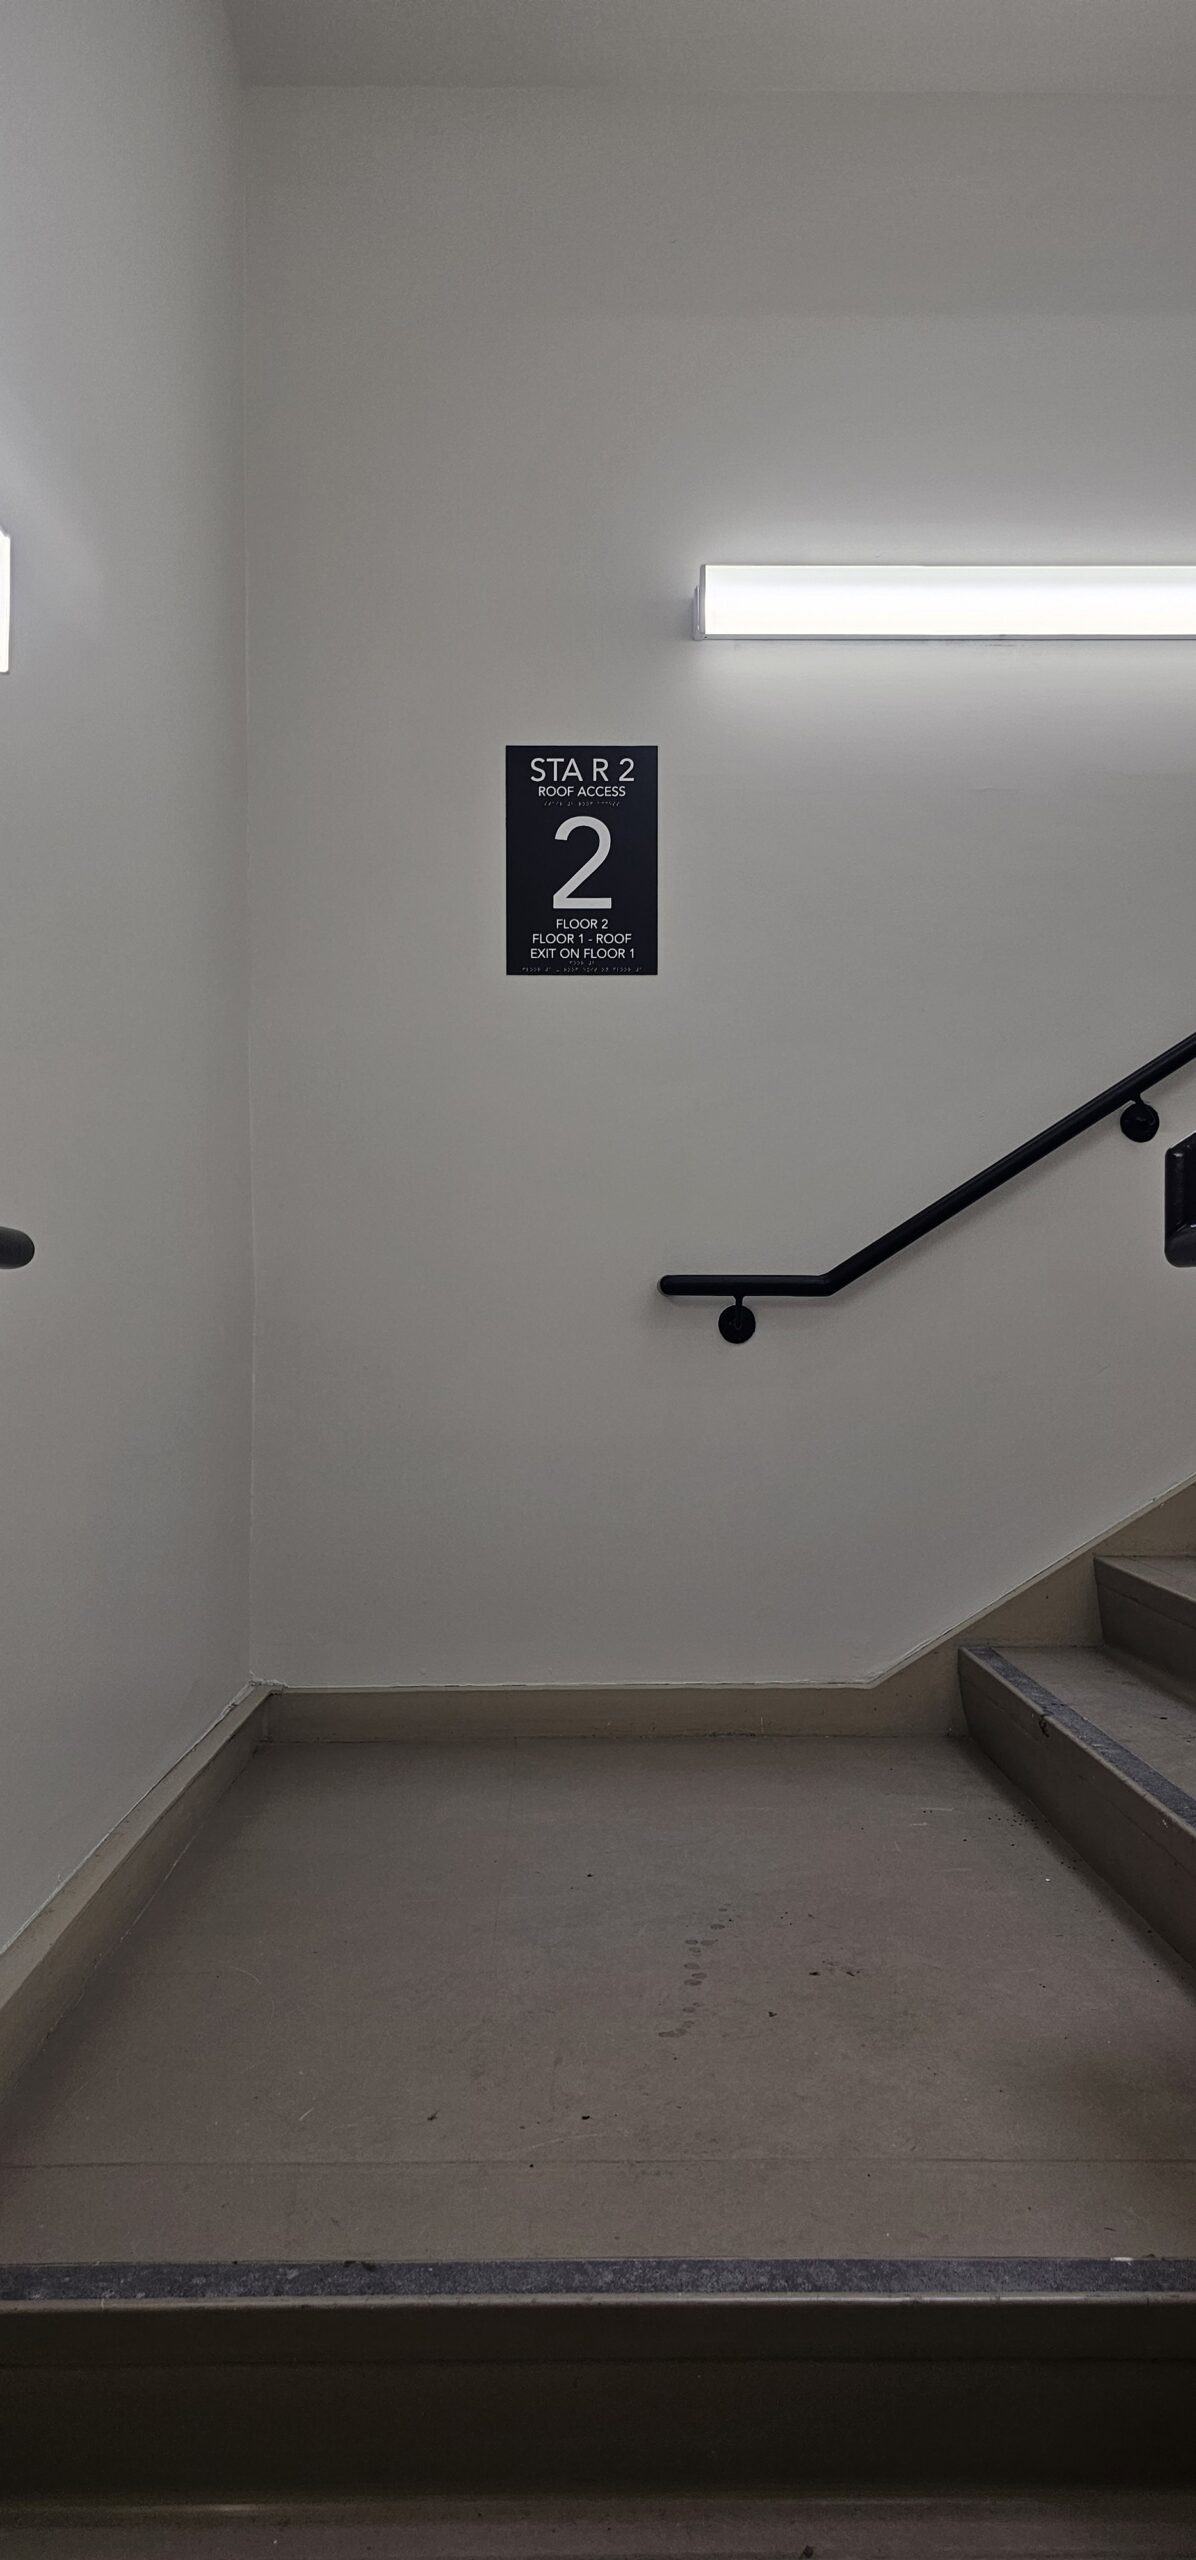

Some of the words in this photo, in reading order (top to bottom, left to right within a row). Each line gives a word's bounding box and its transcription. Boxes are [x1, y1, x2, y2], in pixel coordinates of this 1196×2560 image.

[619, 758, 635, 782] 2
[538, 786, 574, 797] ROOF
[577, 786, 626, 797] ACCESS
[553, 816, 612, 909] 2
[556, 918, 598, 929] FLOOR
[601, 918, 609, 929] 2
[532, 933, 574, 944] FLOOR
[578, 933, 584, 944] 1
[596, 933, 632, 944] ROOF
[530, 948, 556, 959] EXIT
[559, 948, 580, 959] ON
[583, 948, 626, 959] FLOOR
[629, 948, 635, 959] 1
